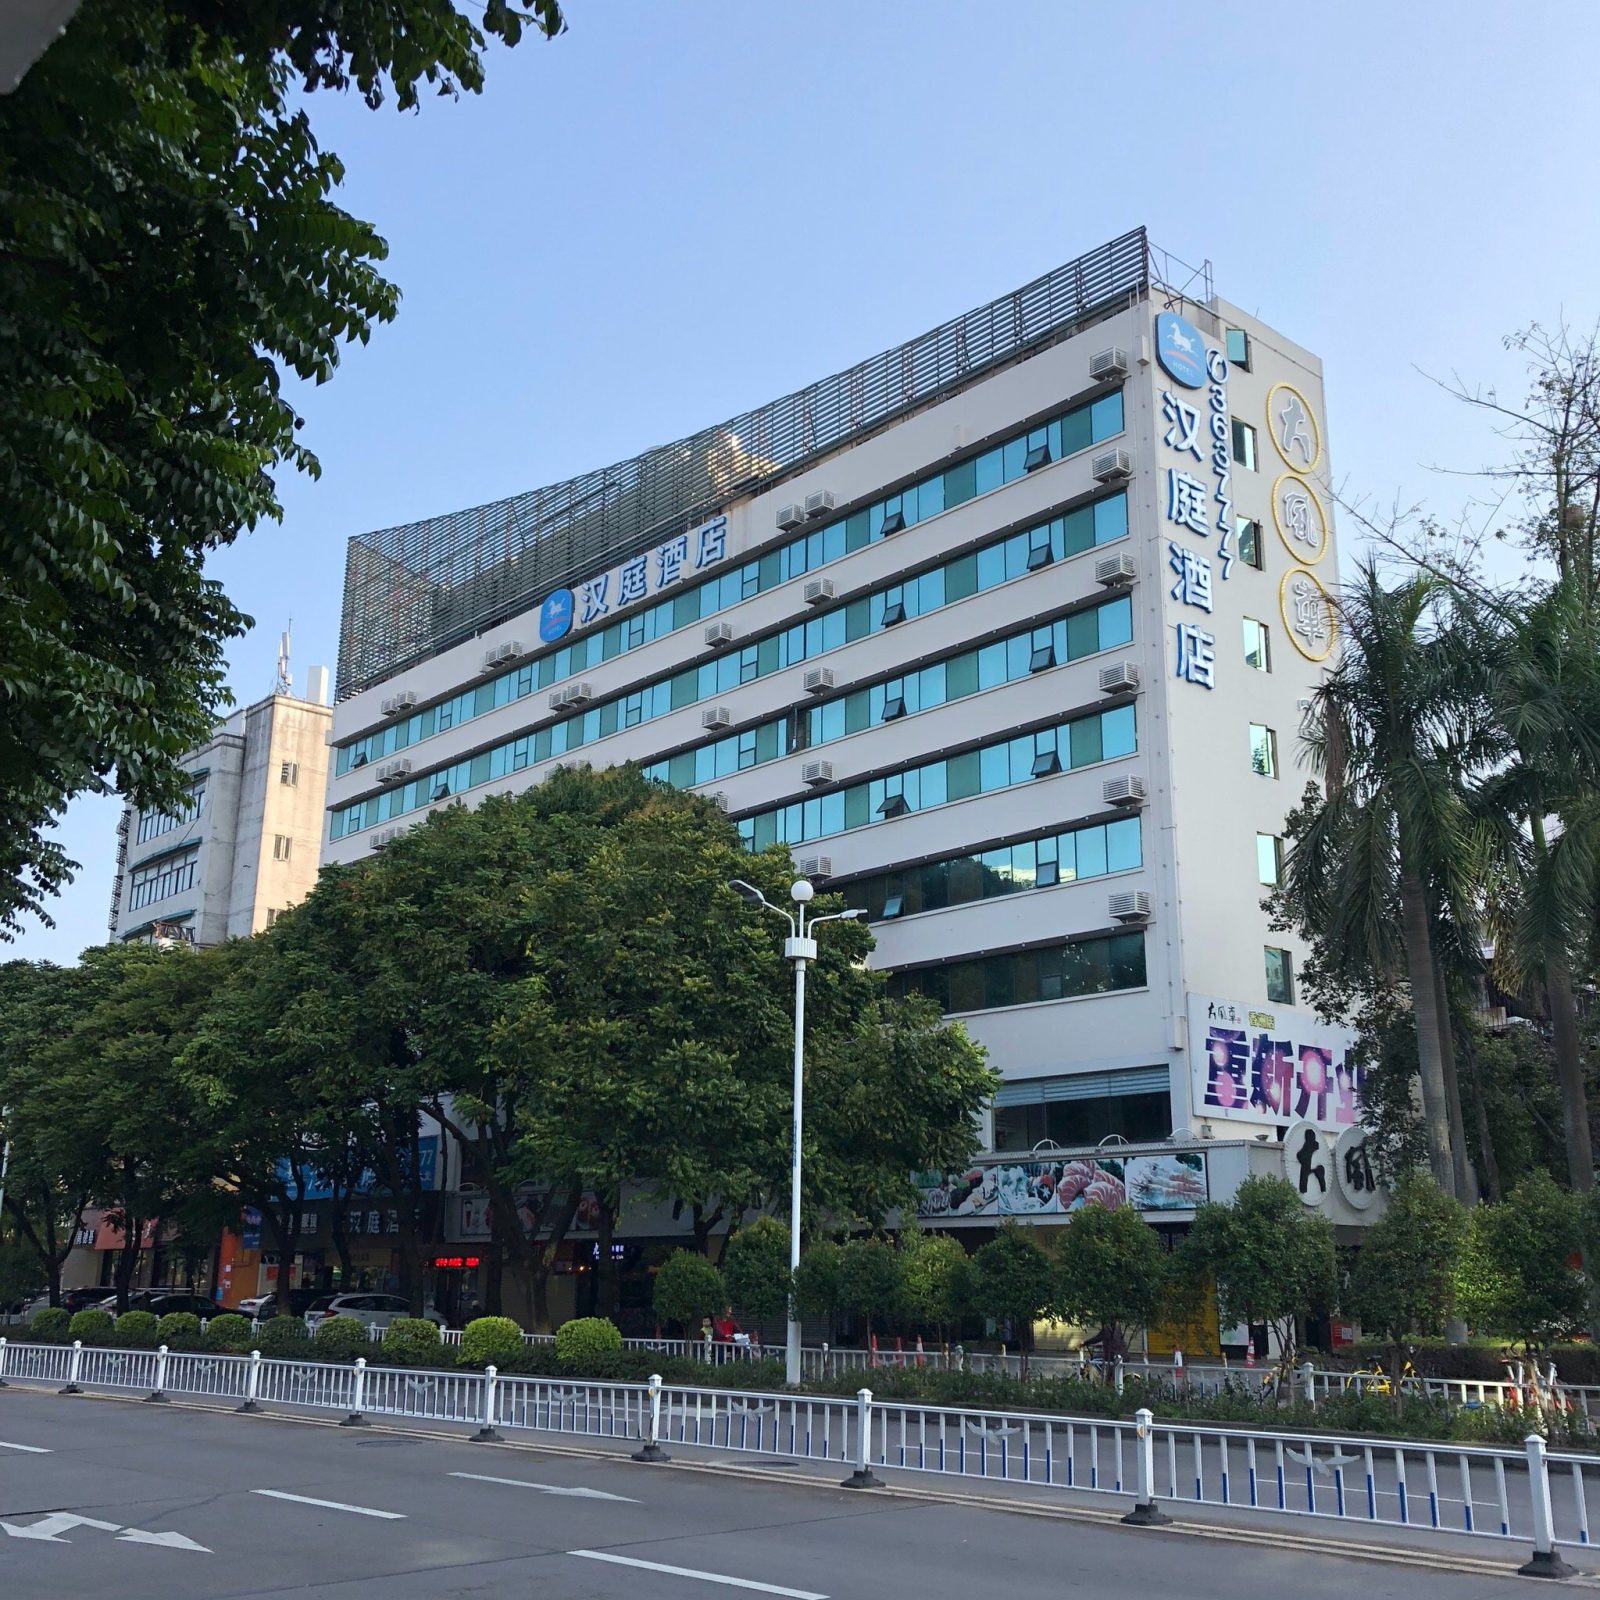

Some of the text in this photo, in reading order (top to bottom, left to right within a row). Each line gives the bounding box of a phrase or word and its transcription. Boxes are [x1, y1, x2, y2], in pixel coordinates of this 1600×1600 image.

[581, 515, 727, 623] 汉庭酒店
[1163, 391, 1216, 690] 汉庭酒店
